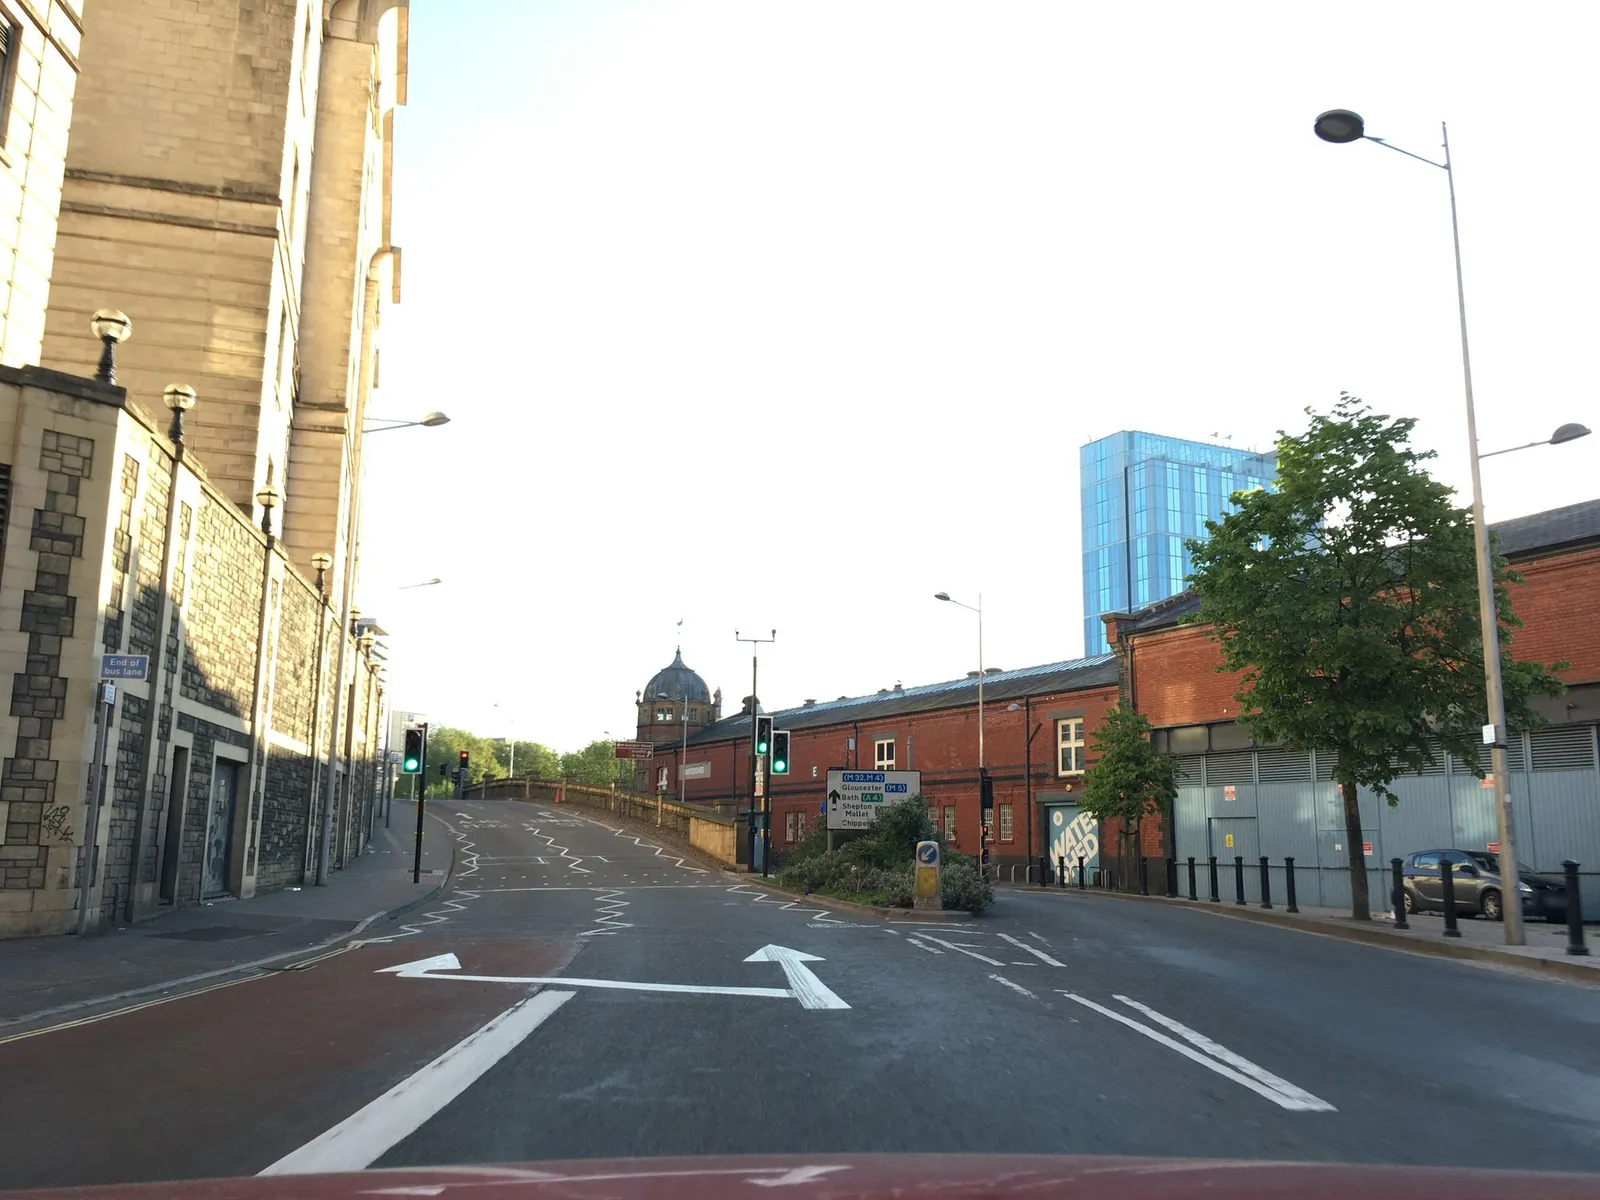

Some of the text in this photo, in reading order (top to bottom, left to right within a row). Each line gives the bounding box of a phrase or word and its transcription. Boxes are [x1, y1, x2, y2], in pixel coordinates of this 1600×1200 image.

[110, 658, 140, 667] End of
[104, 667, 143, 676] bus lane
[842, 784, 882, 792] Gloucester
[842, 803, 872, 811] Shepton
[845, 810, 869, 818] Mallet
